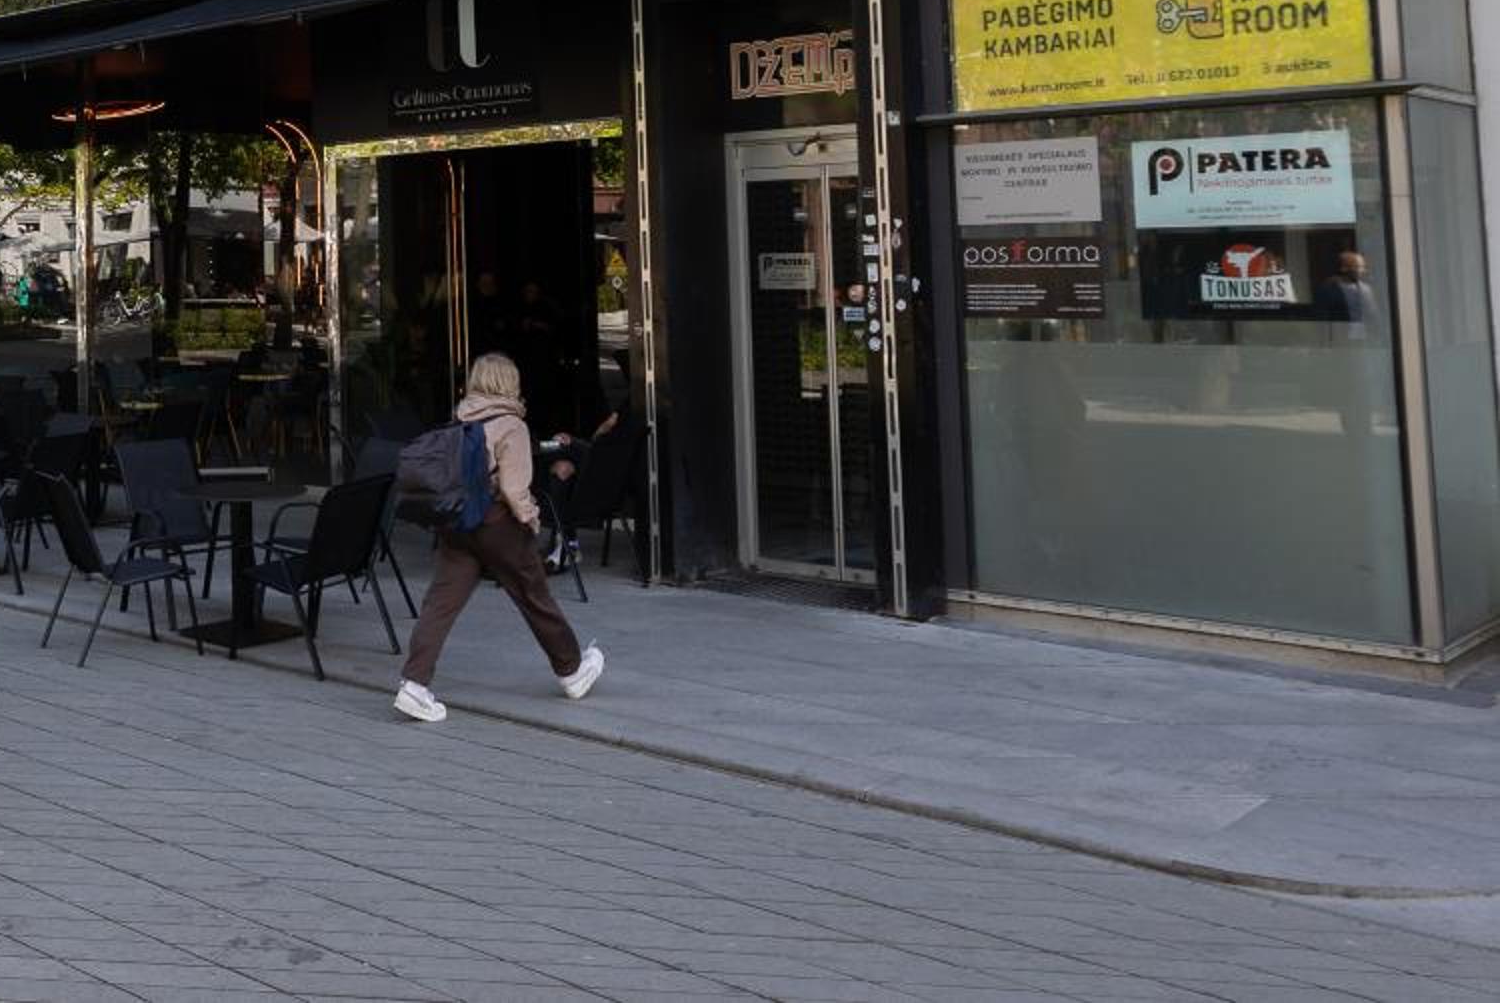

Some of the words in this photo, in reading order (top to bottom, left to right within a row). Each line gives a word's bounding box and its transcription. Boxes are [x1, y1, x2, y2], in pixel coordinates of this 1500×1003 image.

[1232, 0, 1329, 35] ROOM
[985, 25, 1116, 59] KAMBARIAI
[1197, 147, 1331, 174] PATERA
[1203, 277, 1286, 299] TONUSAS
